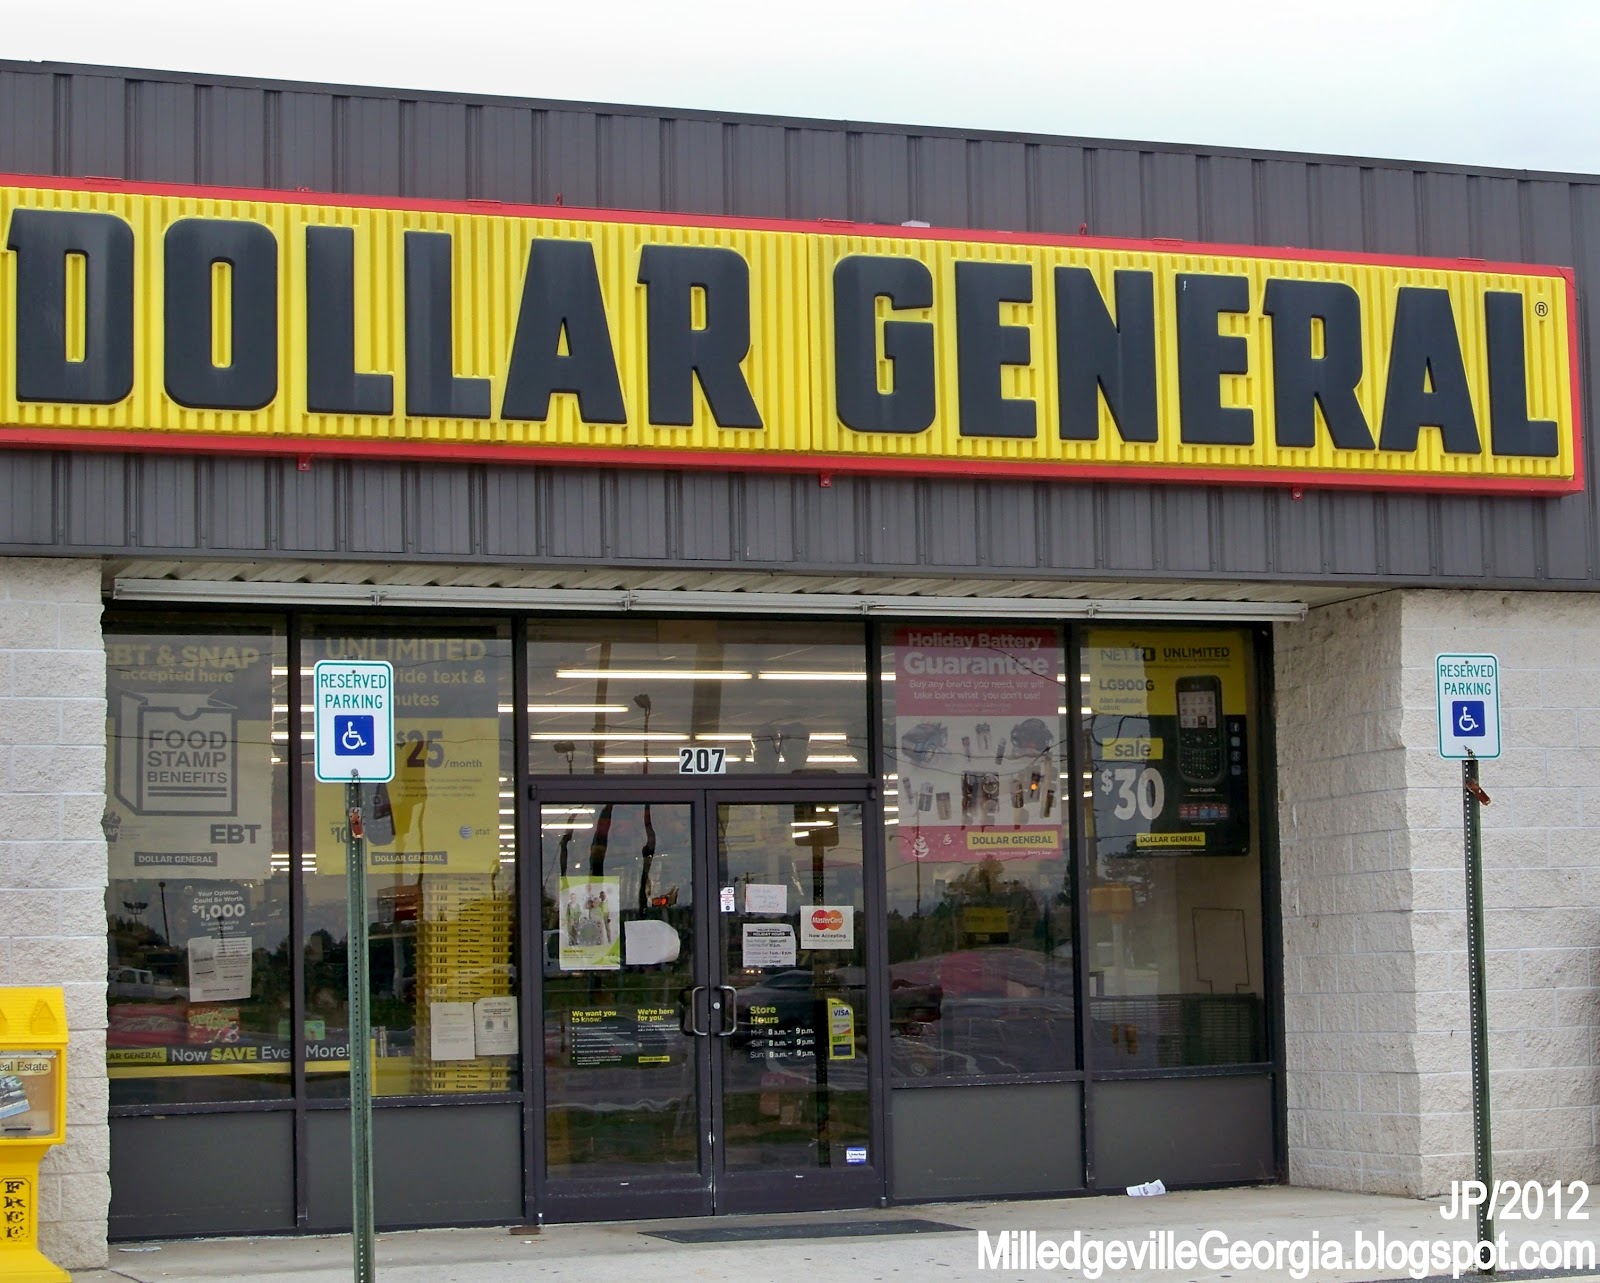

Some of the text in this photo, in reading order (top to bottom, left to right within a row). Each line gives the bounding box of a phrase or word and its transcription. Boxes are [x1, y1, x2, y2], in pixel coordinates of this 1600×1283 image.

[6, 208, 1559, 458] DOLLAR GENERAL
[325, 637, 487, 661] UNLIMITED
[908, 633, 1042, 651] Holiday Battery
[156, 645, 176, 668] &
[181, 645, 260, 669] SNAP
[1163, 647, 1231, 658] UNLIMITED
[903, 651, 1050, 676] Guarantee
[120, 669, 235, 685] accepted here
[395, 668, 487, 684] ide text &
[1440, 664, 1494, 678] RESERVED
[320, 673, 387, 689] RESERVED
[909, 680, 926, 690] Buy
[928, 681, 944, 689] any
[946, 680, 972, 689] brand
[973, 681, 989, 690] you
[1099, 679, 1155, 692] LG900G
[934, 691, 956, 700] back
[957, 691, 979, 700] what
[983, 692, 999, 701] you
[1444, 682, 1492, 696] PARKING
[325, 694, 383, 709] PARKING
[148, 729, 228, 750] FOOD
[1114, 740, 1152, 758] sale
[147, 751, 227, 768] STAMP
[680, 748, 725, 773] 207
[147, 771, 228, 784] BENEFITS
[1101, 767, 1165, 820] $30
[210, 824, 262, 844] EBT
[972, 835, 1053, 845] DOLLAR GENERAL
[1170, 835, 1202, 843] GENERAL
[138, 855, 213, 863] DOLLAR GENERAL
[407, 854, 444, 862] GENERAL
[192, 903, 246, 921] $1,000
[603, 1010, 617, 1018] you
[637, 1008, 658, 1016] We're
[750, 1006, 777, 1015] Store
[833, 1009, 850, 1017] VISA
[637, 1014, 648, 1022] for
[750, 1016, 780, 1025] Hours
[801, 1028, 814, 1036] p.m.
[832, 1035, 847, 1043] EBT
[123, 1051, 162, 1059] GENERAL
[172, 1048, 207, 1062] Now
[211, 1047, 258, 1061] SAVE
[262, 1046, 290, 1059] Eve
[305, 1043, 350, 1058] More!
[0, 1061, 48, 1072] eal Estate
